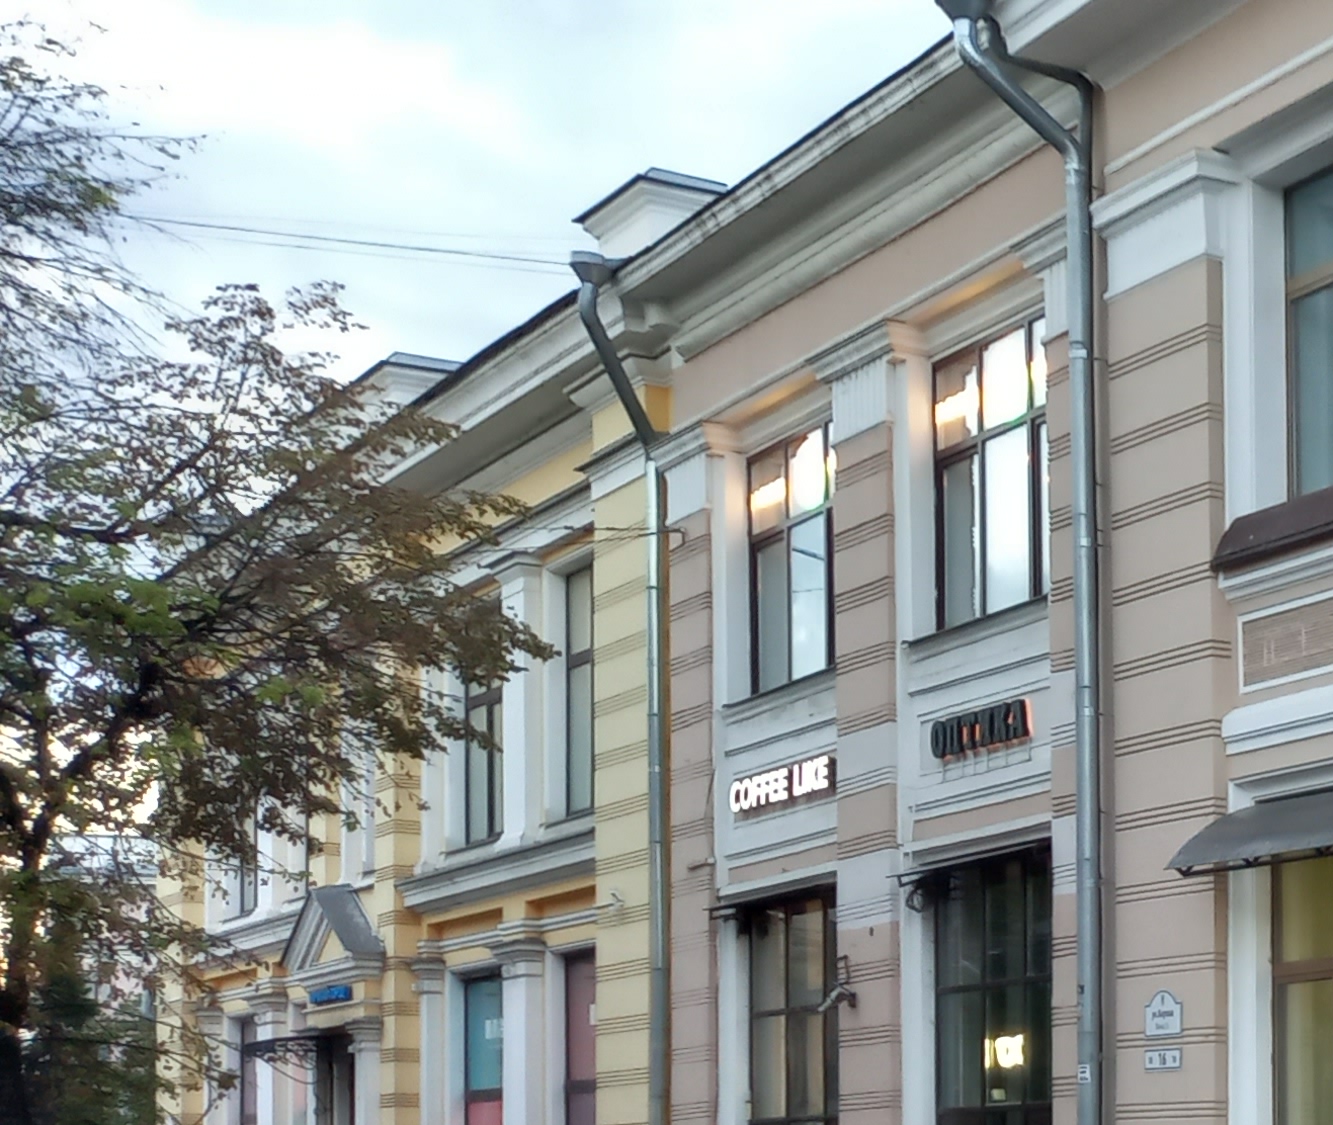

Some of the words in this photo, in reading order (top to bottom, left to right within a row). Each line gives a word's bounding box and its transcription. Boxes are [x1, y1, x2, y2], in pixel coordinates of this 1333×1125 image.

[930, 698, 1031, 759] ОПТИКА
[730, 767, 788, 813] COFFEE
[793, 755, 828, 797] LIKE
